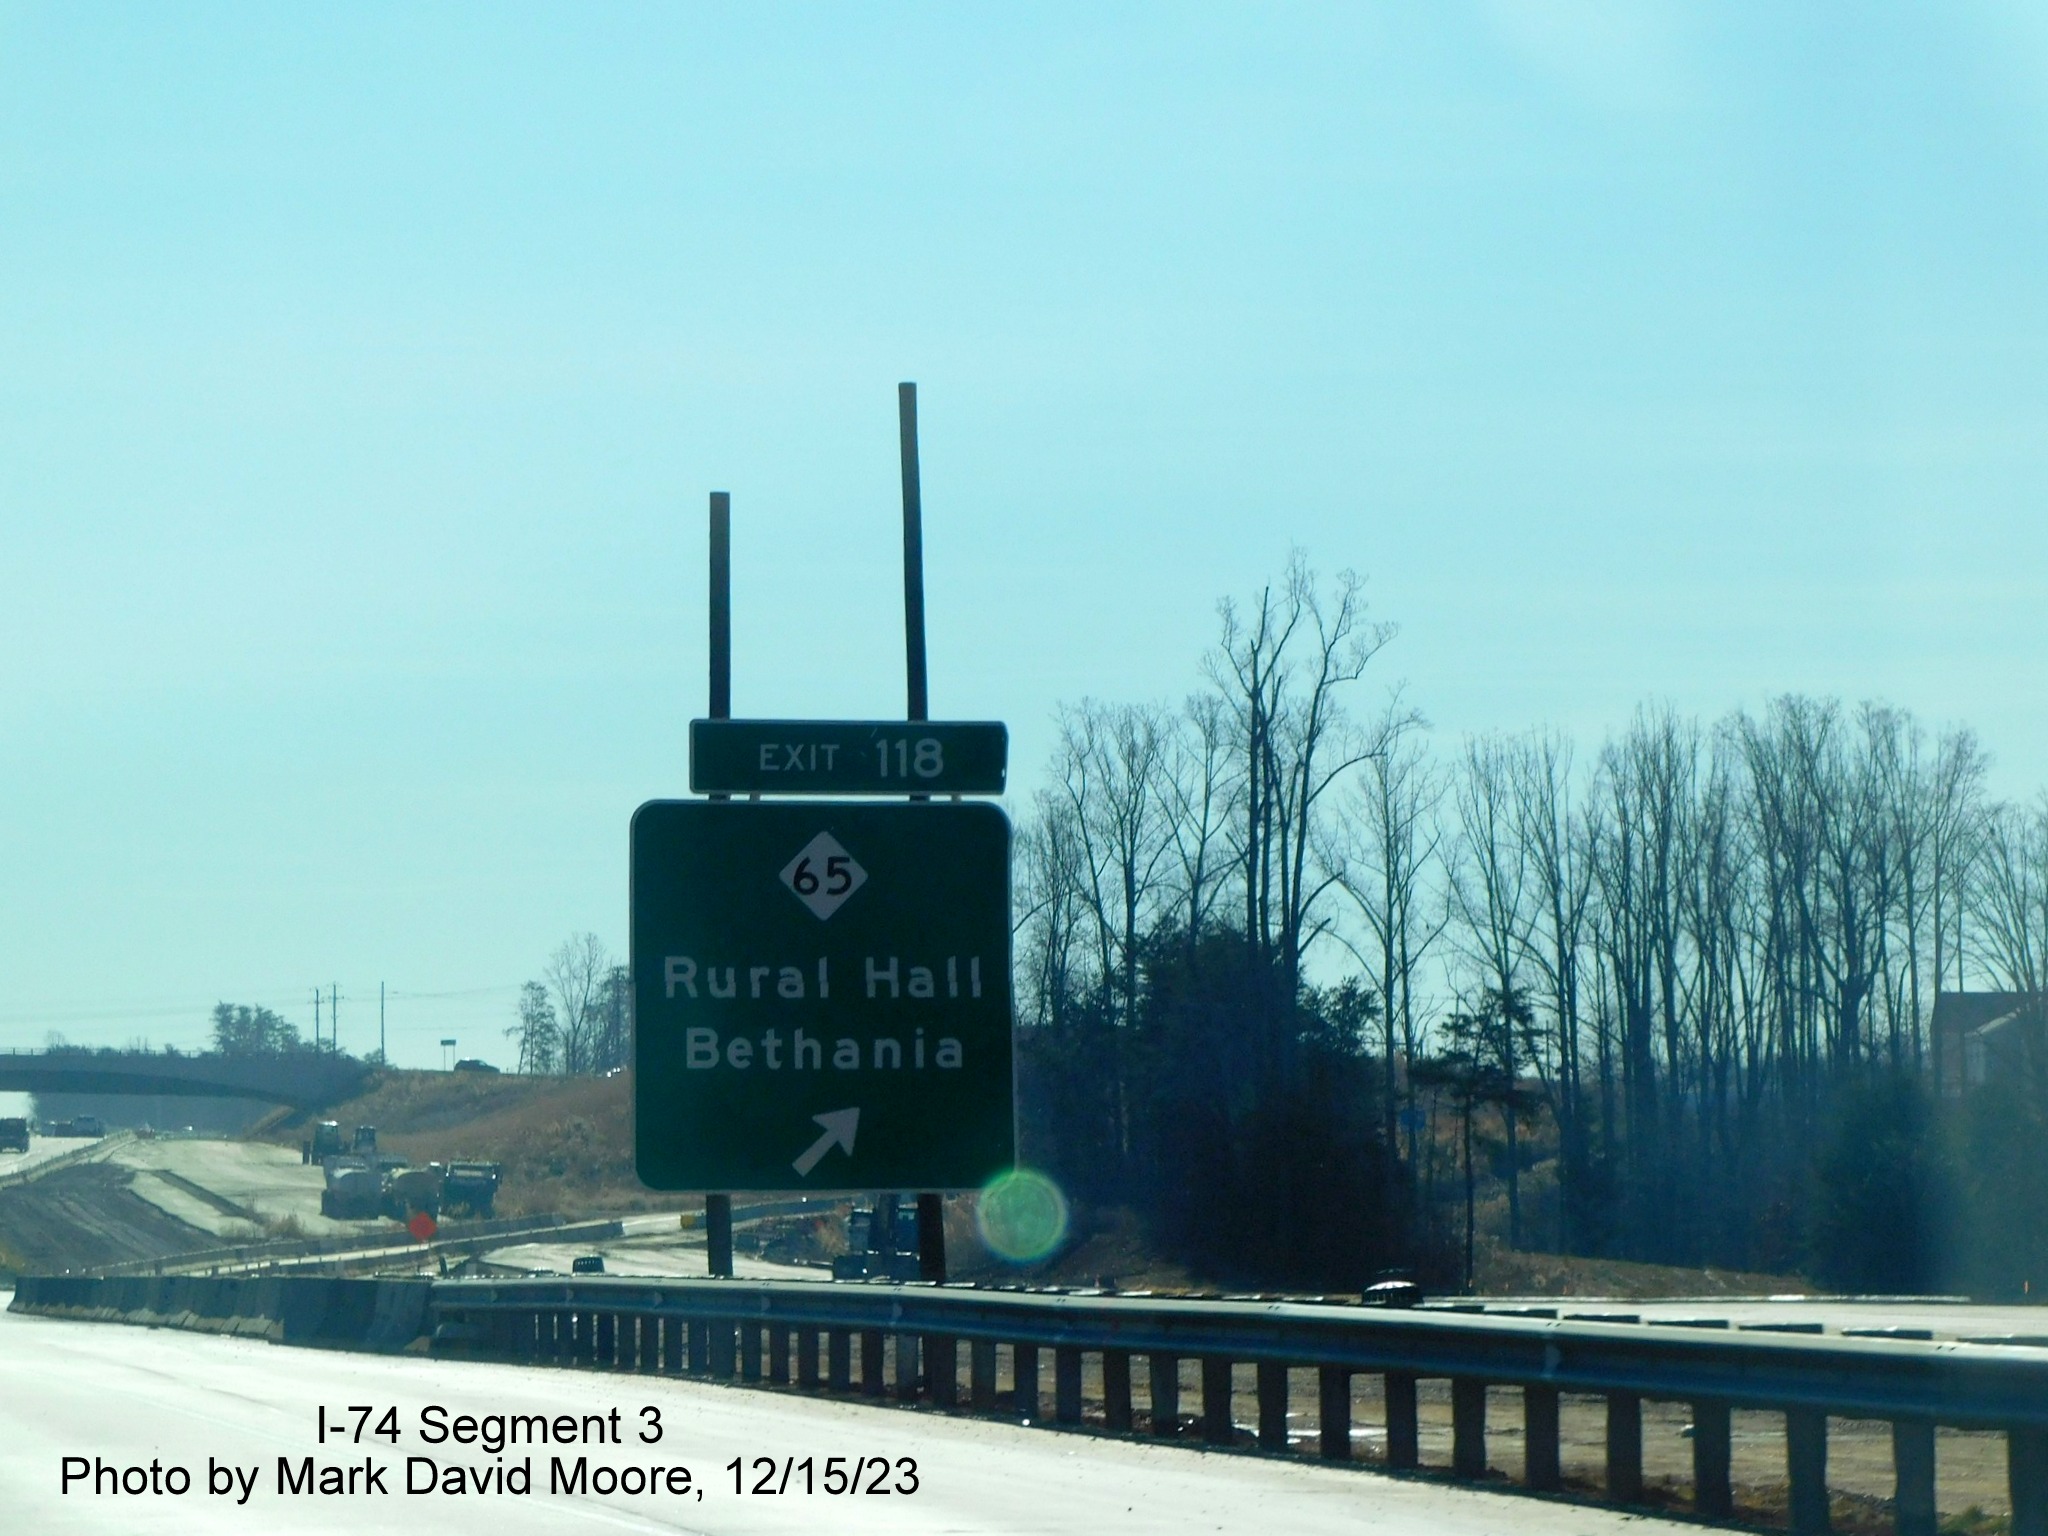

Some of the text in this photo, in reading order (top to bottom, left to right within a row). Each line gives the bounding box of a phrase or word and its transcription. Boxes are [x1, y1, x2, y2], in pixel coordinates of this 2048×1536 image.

[759, 738, 944, 779] EXIT 118
[793, 857, 853, 896] 65
[665, 955, 983, 1000] Rural Hall
[686, 1027, 964, 1071] Bethania
